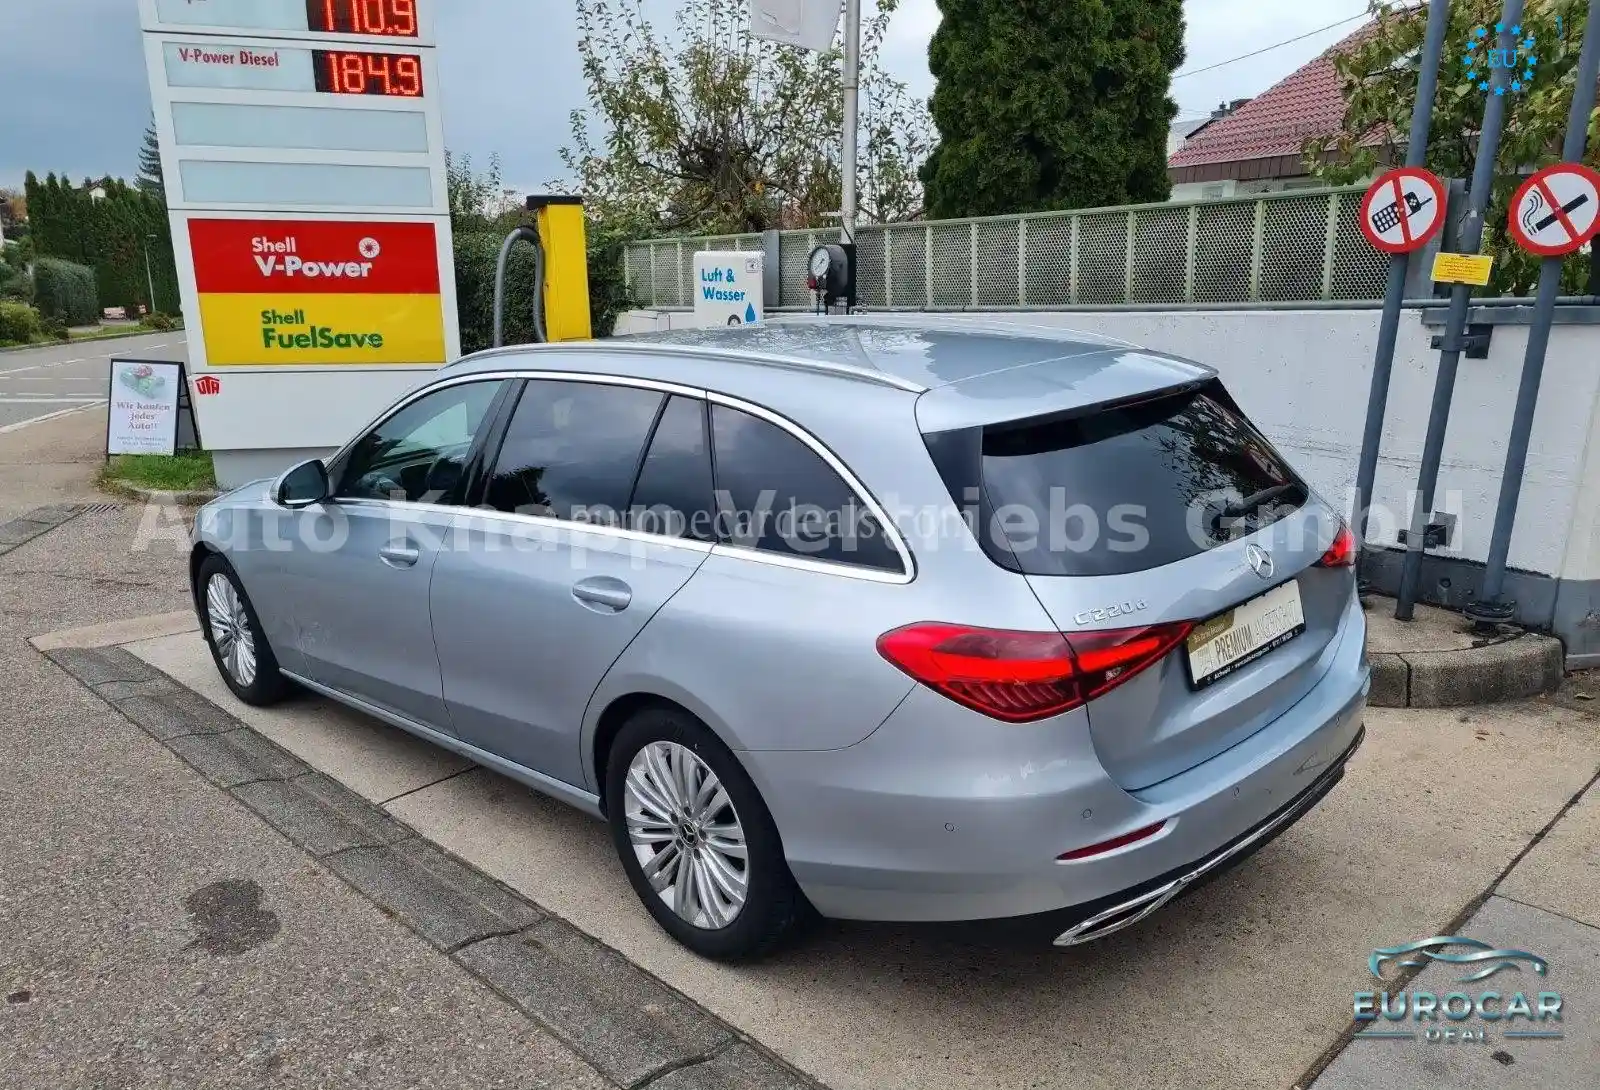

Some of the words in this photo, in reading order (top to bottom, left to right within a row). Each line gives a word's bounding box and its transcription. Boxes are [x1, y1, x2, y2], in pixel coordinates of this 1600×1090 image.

[178, 47, 235, 64] V-Power
[240, 50, 279, 66] Diesel
[329, 53, 420, 95] 184.9
[251, 237, 296, 253] Shell
[254, 255, 373, 278] V-Power
[701, 267, 723, 282] Luft
[726, 268, 735, 282] &
[703, 286, 745, 301] Wasser
[261, 310, 305, 325] Shell
[262, 326, 383, 349] FuelSave
